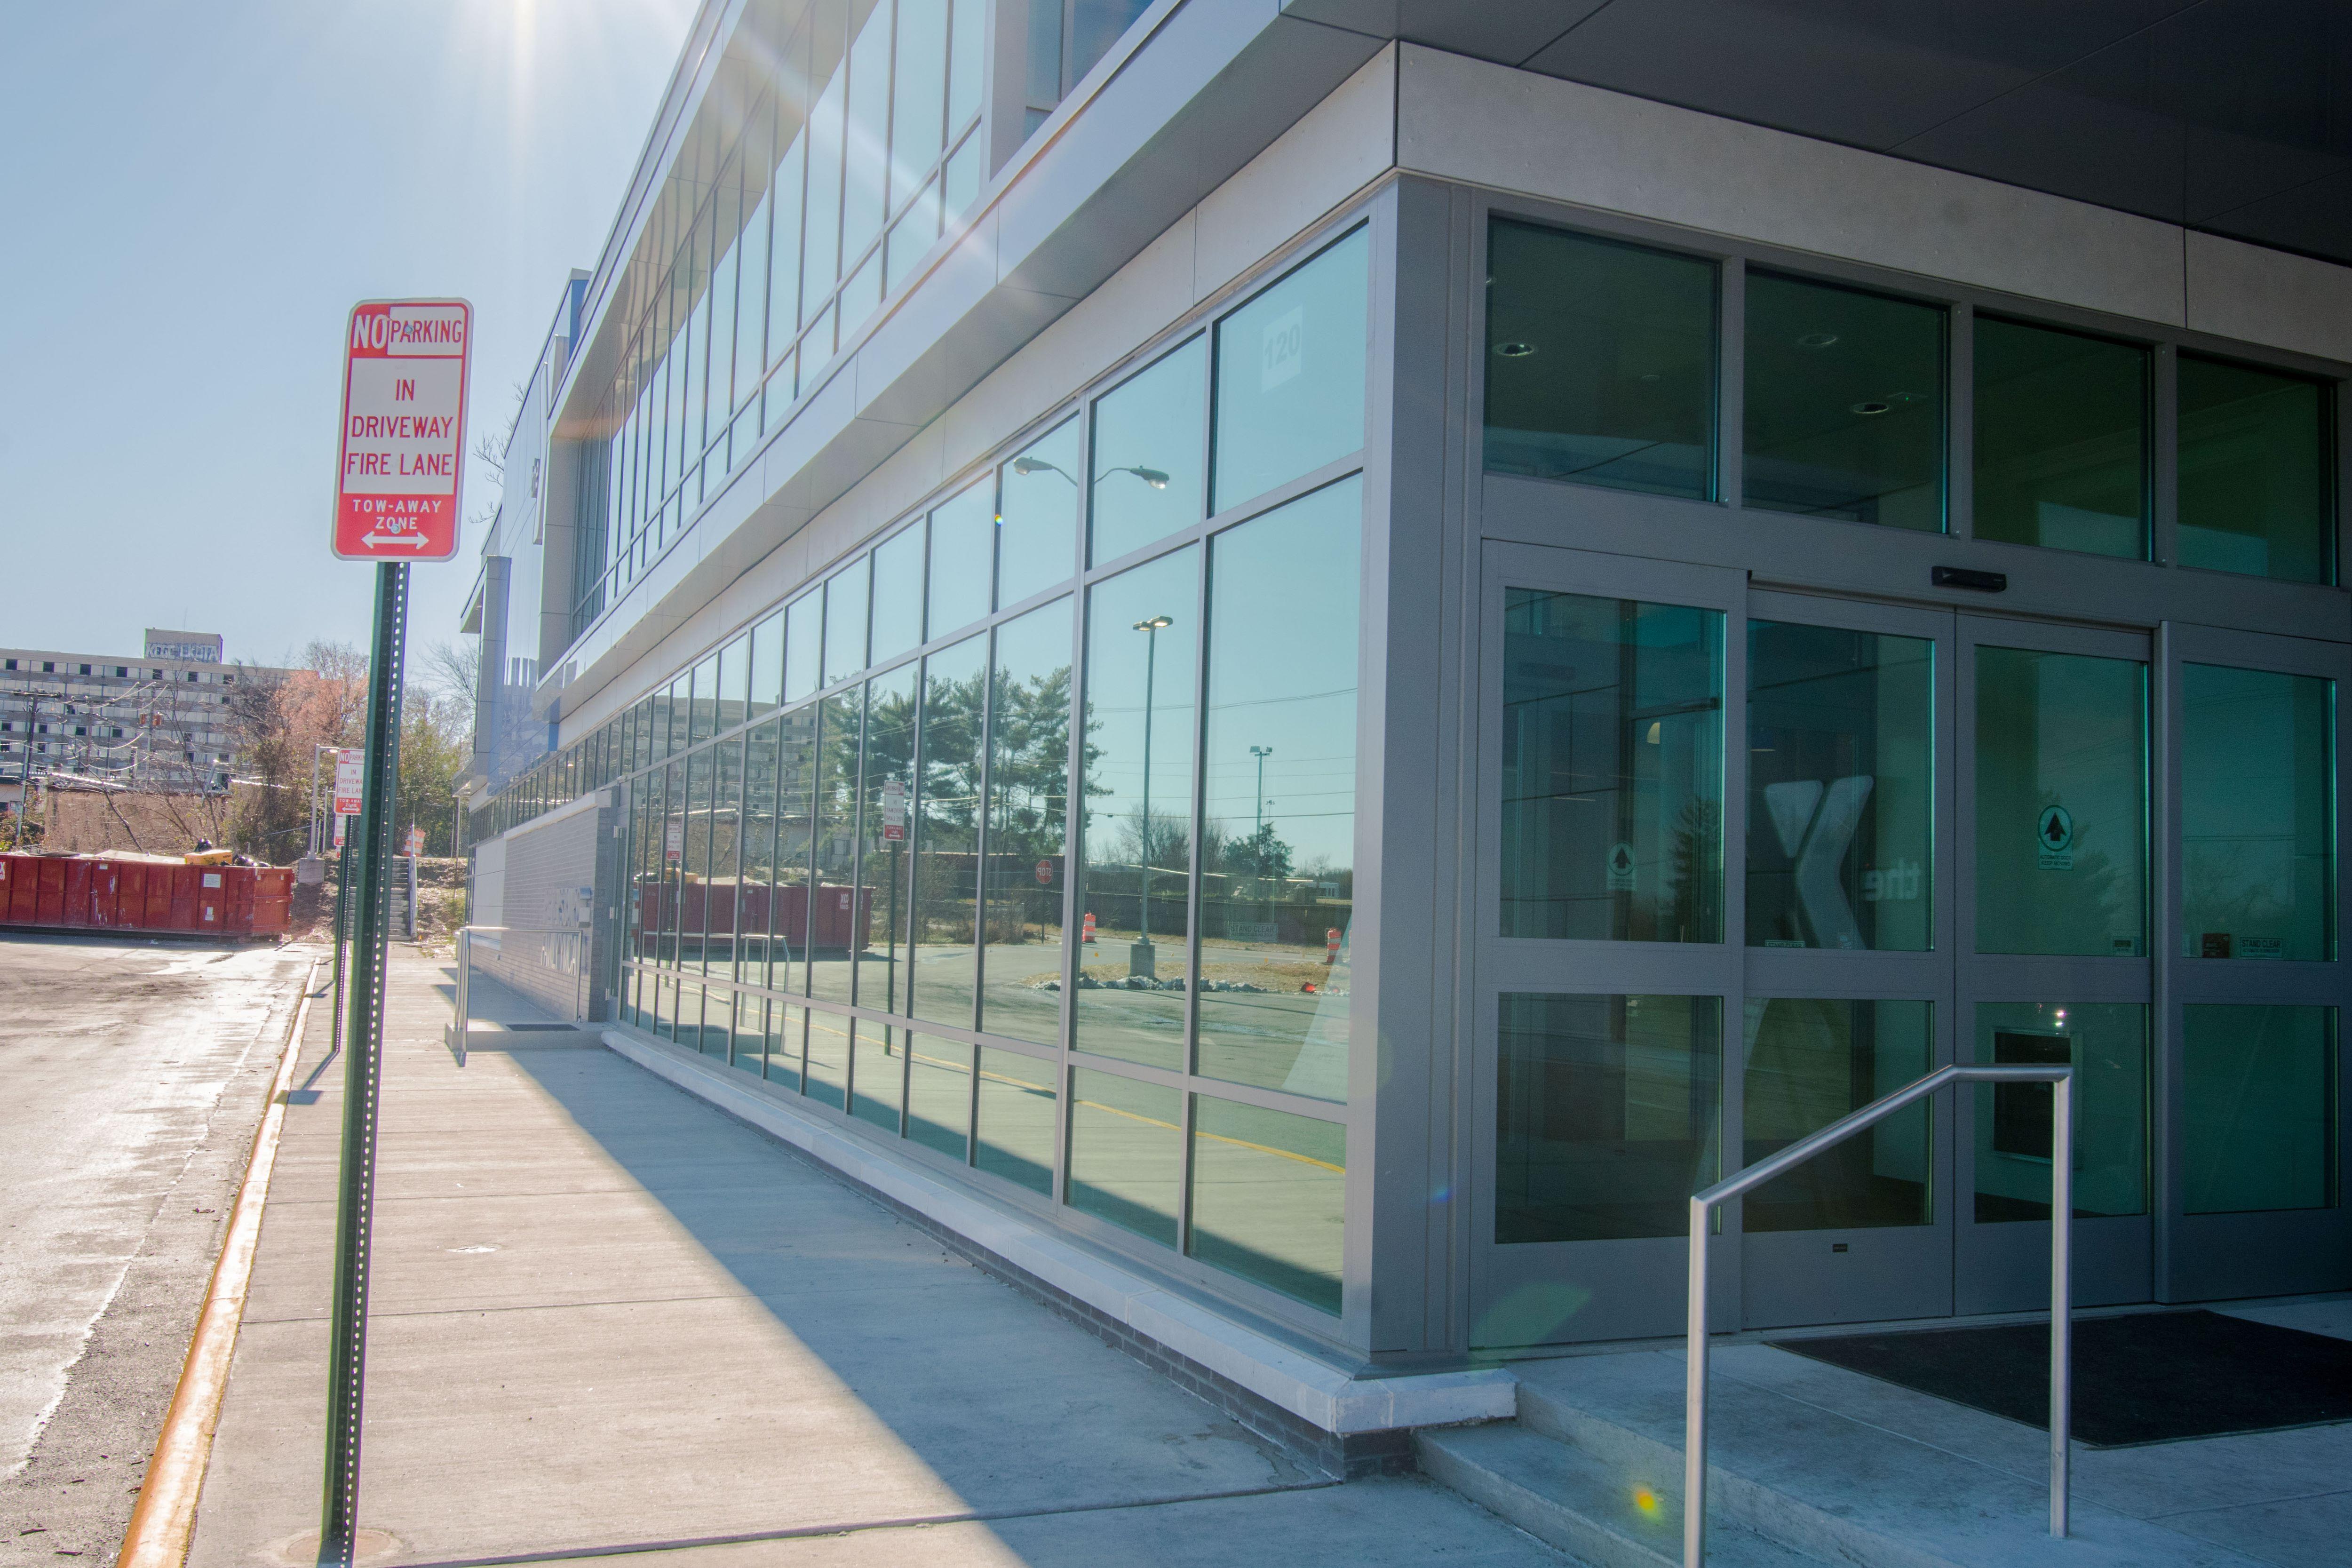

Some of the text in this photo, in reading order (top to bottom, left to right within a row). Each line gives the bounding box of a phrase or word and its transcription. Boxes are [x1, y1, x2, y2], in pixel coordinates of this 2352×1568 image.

[353, 314, 463, 349] NO PARKING
[1264, 324, 1300, 370] 120
[395, 379, 414, 401] IN
[351, 415, 453, 438] DRIVEWAY
[347, 453, 453, 476] FIRE LANE
[353, 499, 442, 513] TOW-AWAY
[375, 517, 417, 530] ZONE
[2242, 939, 2261, 947] STAND
